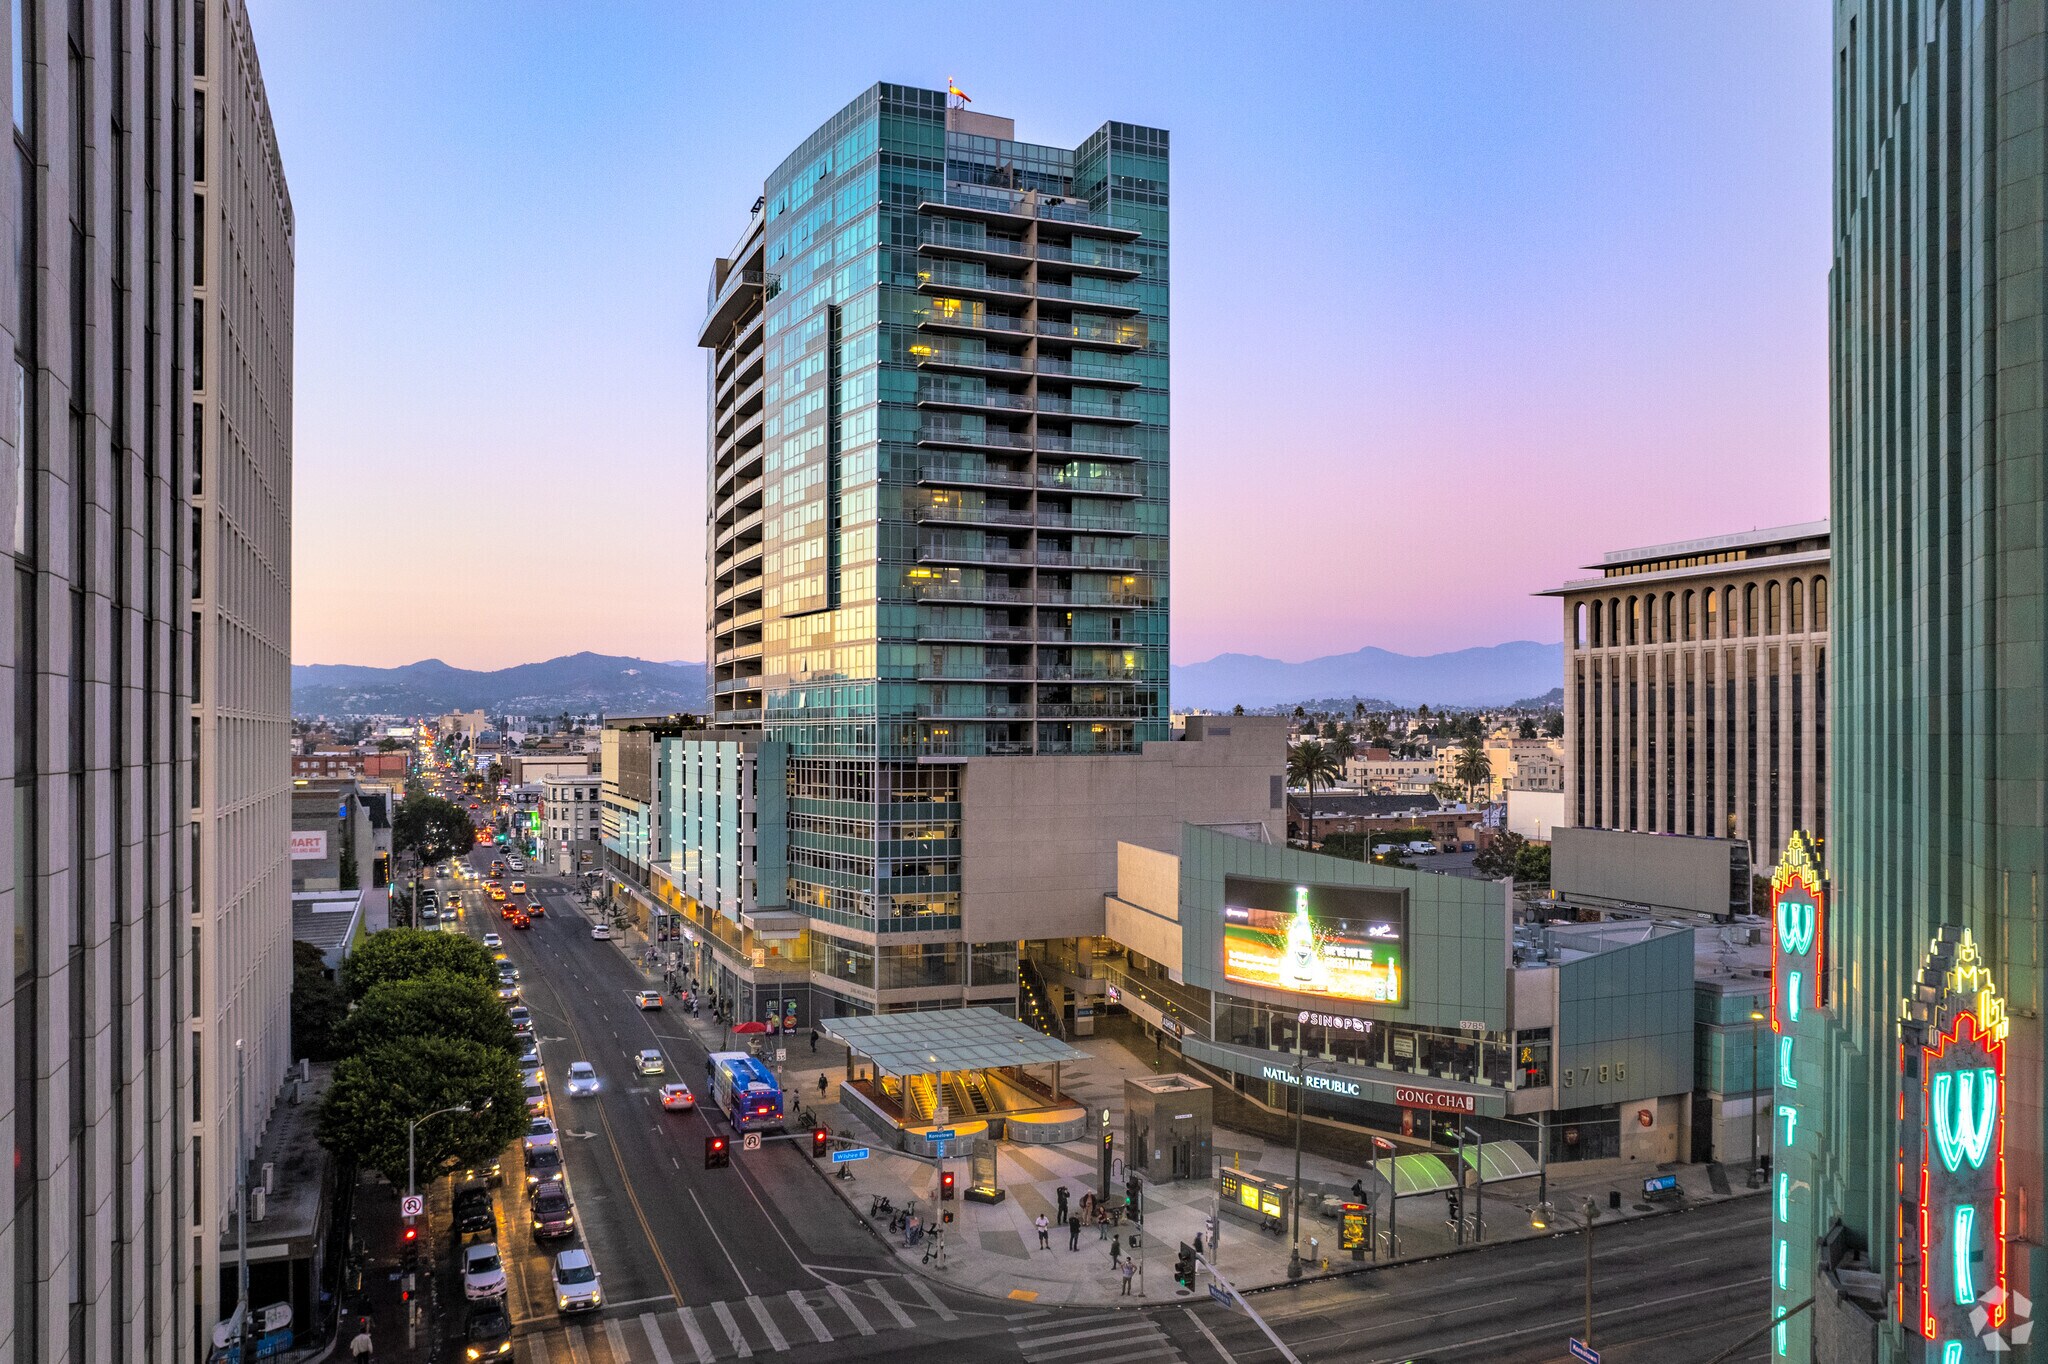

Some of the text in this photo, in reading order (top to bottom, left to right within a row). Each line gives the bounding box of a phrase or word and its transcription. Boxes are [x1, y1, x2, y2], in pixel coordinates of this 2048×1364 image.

[1310, 1012, 1373, 1033] SINOPOT
[1461, 1021, 1484, 1030] 3785
[1306, 1075, 1360, 1096] REPUBLIC
[1564, 1062, 1626, 1089] 3785
[1396, 1089, 1433, 1105] GONG
[1437, 1094, 1465, 1109] CHA
